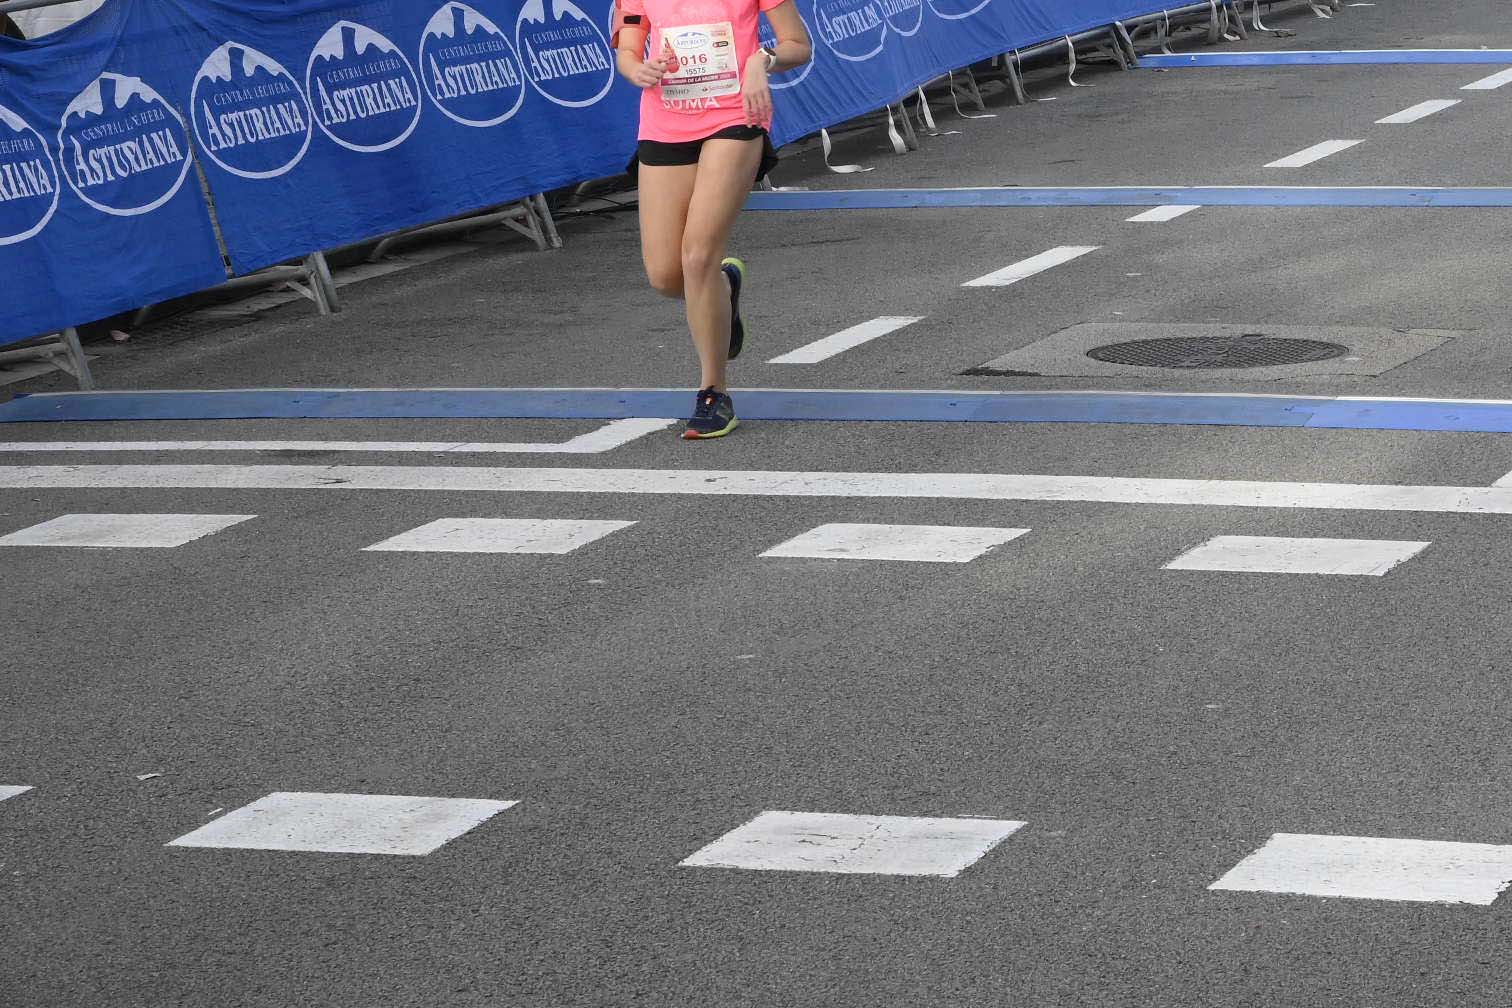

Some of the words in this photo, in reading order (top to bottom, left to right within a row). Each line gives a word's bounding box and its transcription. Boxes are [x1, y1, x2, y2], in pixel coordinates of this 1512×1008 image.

[327, 65, 363, 83] CENTRAL
[363, 59, 401, 78] LECHERA
[429, 51, 521, 102] ASTURIANA
[525, 37, 610, 83] ASTURIANA
[685, 67, 707, 75] 15575
[213, 87, 253, 107] CENTRAL
[254, 82, 292, 101] LECHERA
[316, 74, 416, 126] ASTURIANA
[203, 96, 306, 151] ASTURIANA
